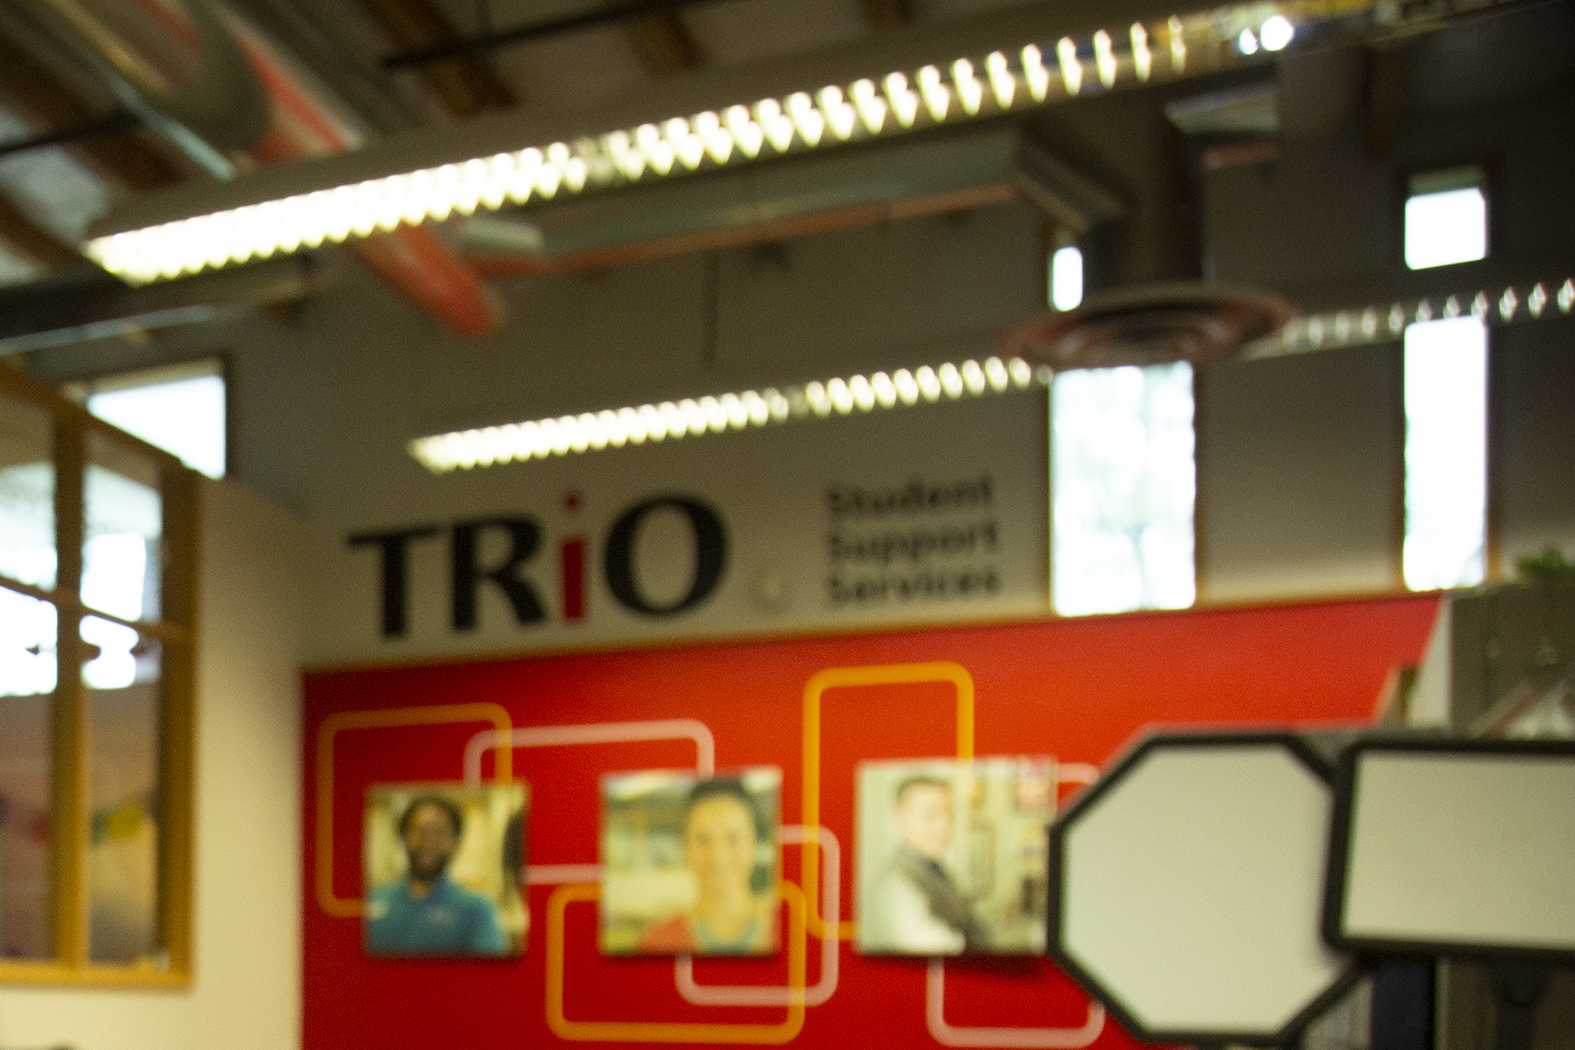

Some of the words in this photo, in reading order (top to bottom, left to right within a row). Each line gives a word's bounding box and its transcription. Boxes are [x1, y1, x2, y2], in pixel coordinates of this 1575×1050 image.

[828, 475, 995, 519] Student
[828, 520, 999, 565] Support
[346, 490, 732, 640] TRiO
[828, 569, 1001, 606] Services
